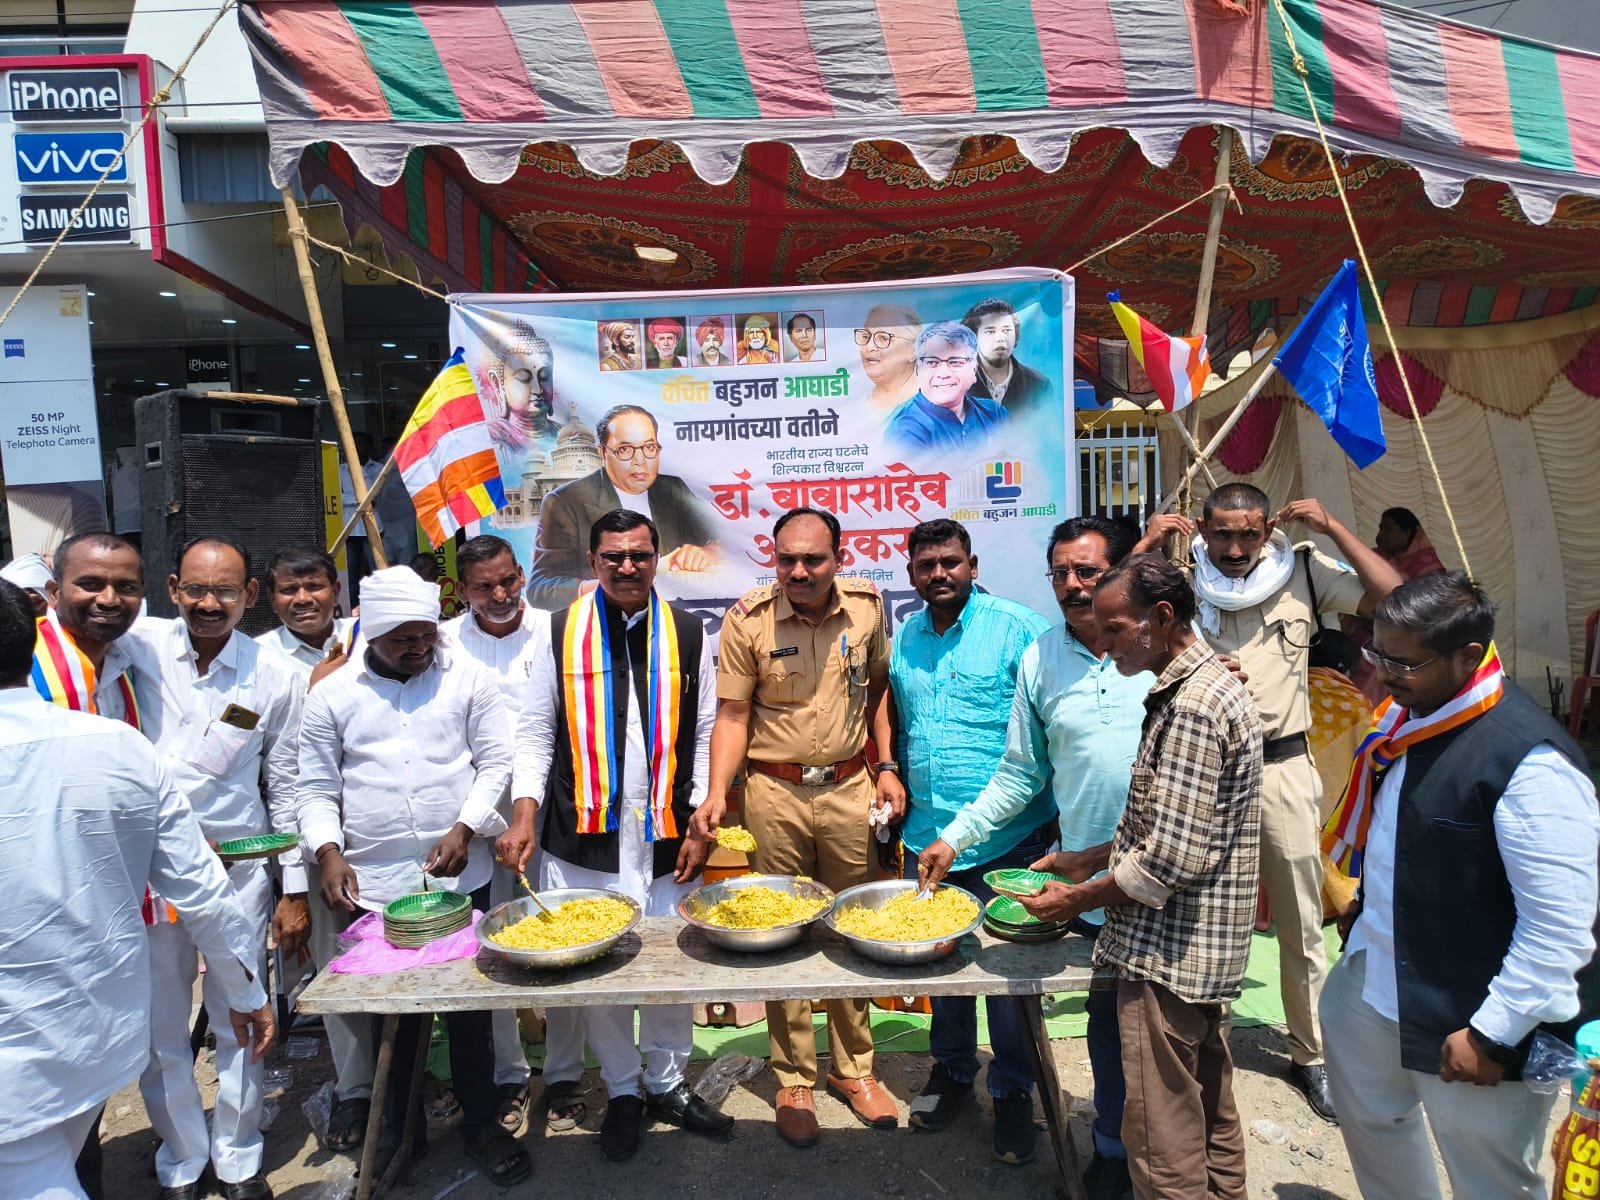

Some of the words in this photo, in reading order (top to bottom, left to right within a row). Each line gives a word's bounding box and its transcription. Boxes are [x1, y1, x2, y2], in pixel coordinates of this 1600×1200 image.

[12, 81, 118, 111] iPhone
[19, 142, 123, 174] vivo
[22, 206, 129, 231] SAMSUNG
[188, 358, 228, 371] iPhone
[660, 374, 710, 404] वंचित
[713, 377, 779, 408] बहुजन
[784, 368, 850, 398] आघाडी
[31, 413, 45, 423] 50
[47, 412, 65, 422] MP
[674, 413, 782, 442] नायगांवच्या
[785, 408, 840, 438] वतीने
[18, 426, 49, 436] ZEISS
[52, 424, 82, 436] Night
[6, 440, 55, 449] Telephoto
[58, 437, 95, 446] Camera
[766, 446, 806, 461] भारतीय
[808, 447, 833, 459] राज्य
[835, 444, 869, 457] घटनेचे
[772, 462, 821, 476] शिल्पकार
[823, 460, 865, 474] विश्वरत्न
[767, 462, 952, 524] बाबासाहेब
[983, 508, 1017, 522] बहुजन
[1021, 503, 1057, 517] आघाडी
[1563, 1133, 1600, 1200] SB
